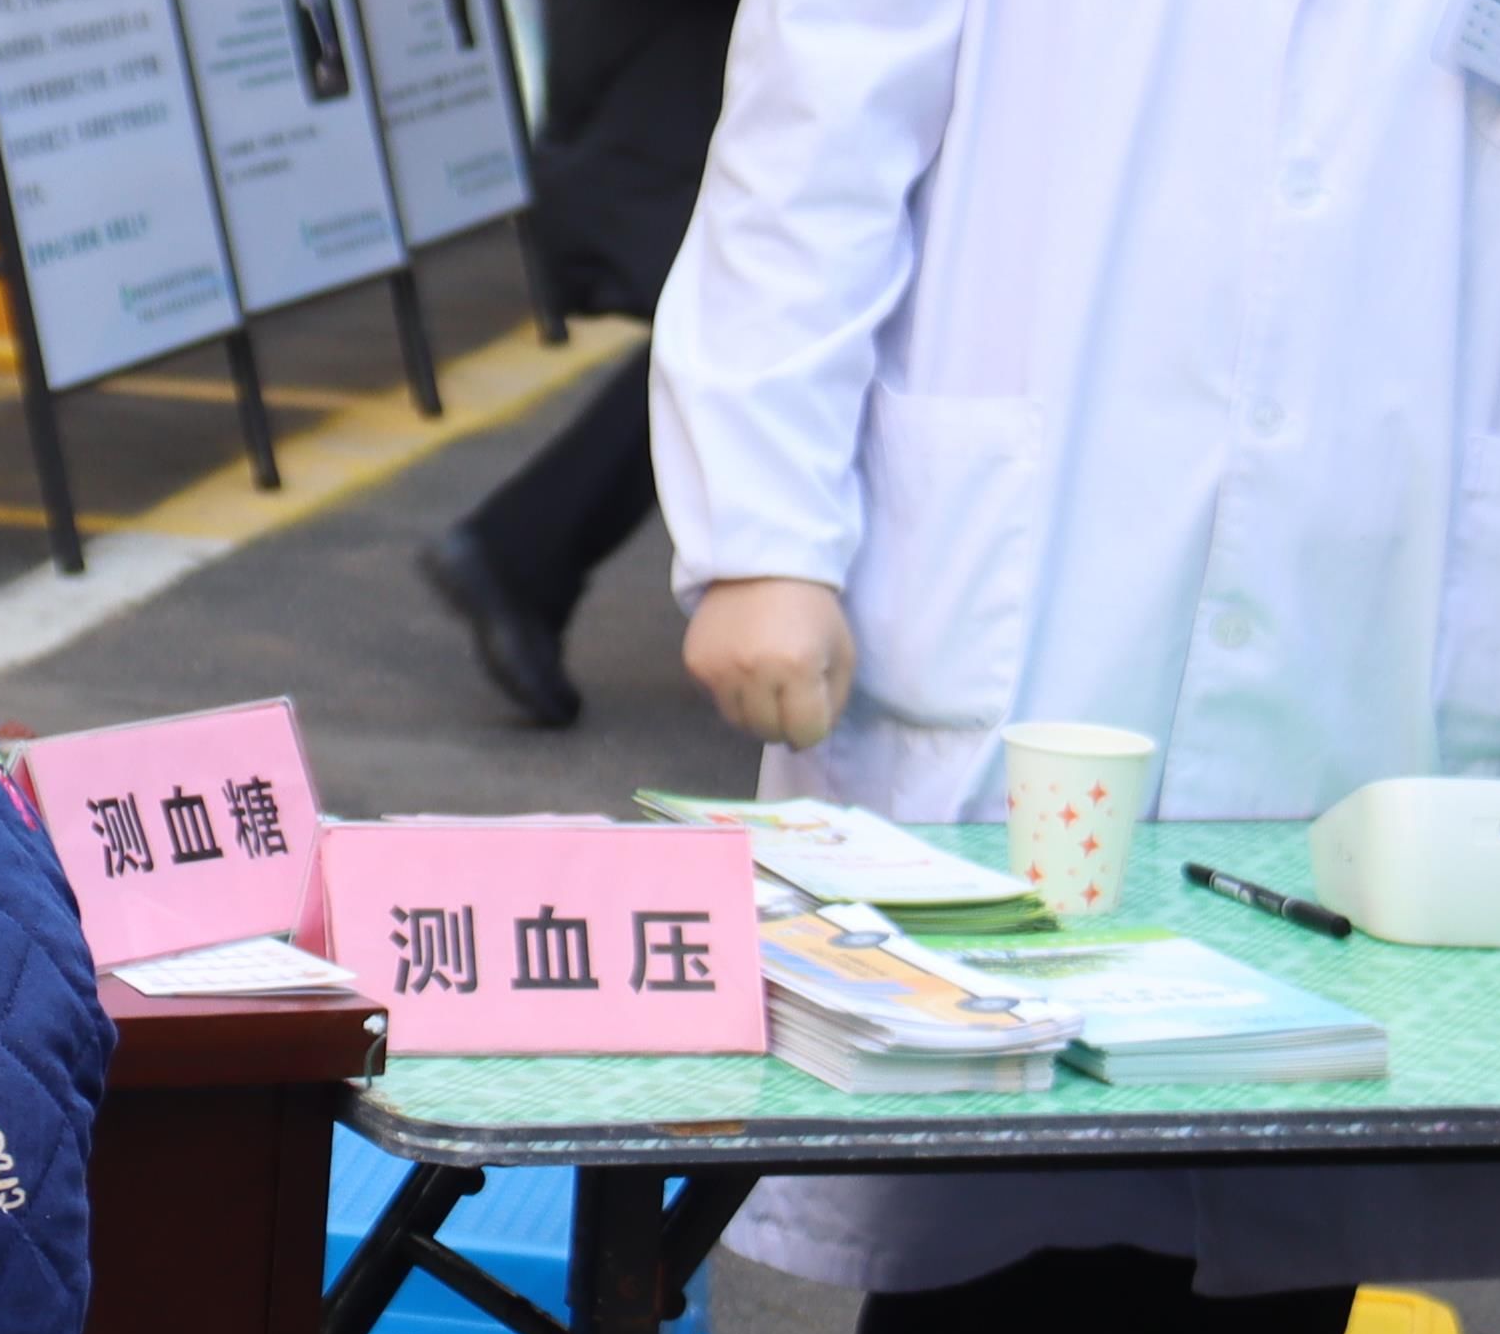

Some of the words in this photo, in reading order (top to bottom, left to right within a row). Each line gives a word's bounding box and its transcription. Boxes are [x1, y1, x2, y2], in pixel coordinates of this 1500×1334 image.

[86, 775, 290, 879] 测血糖
[388, 904, 717, 995] 测血压
